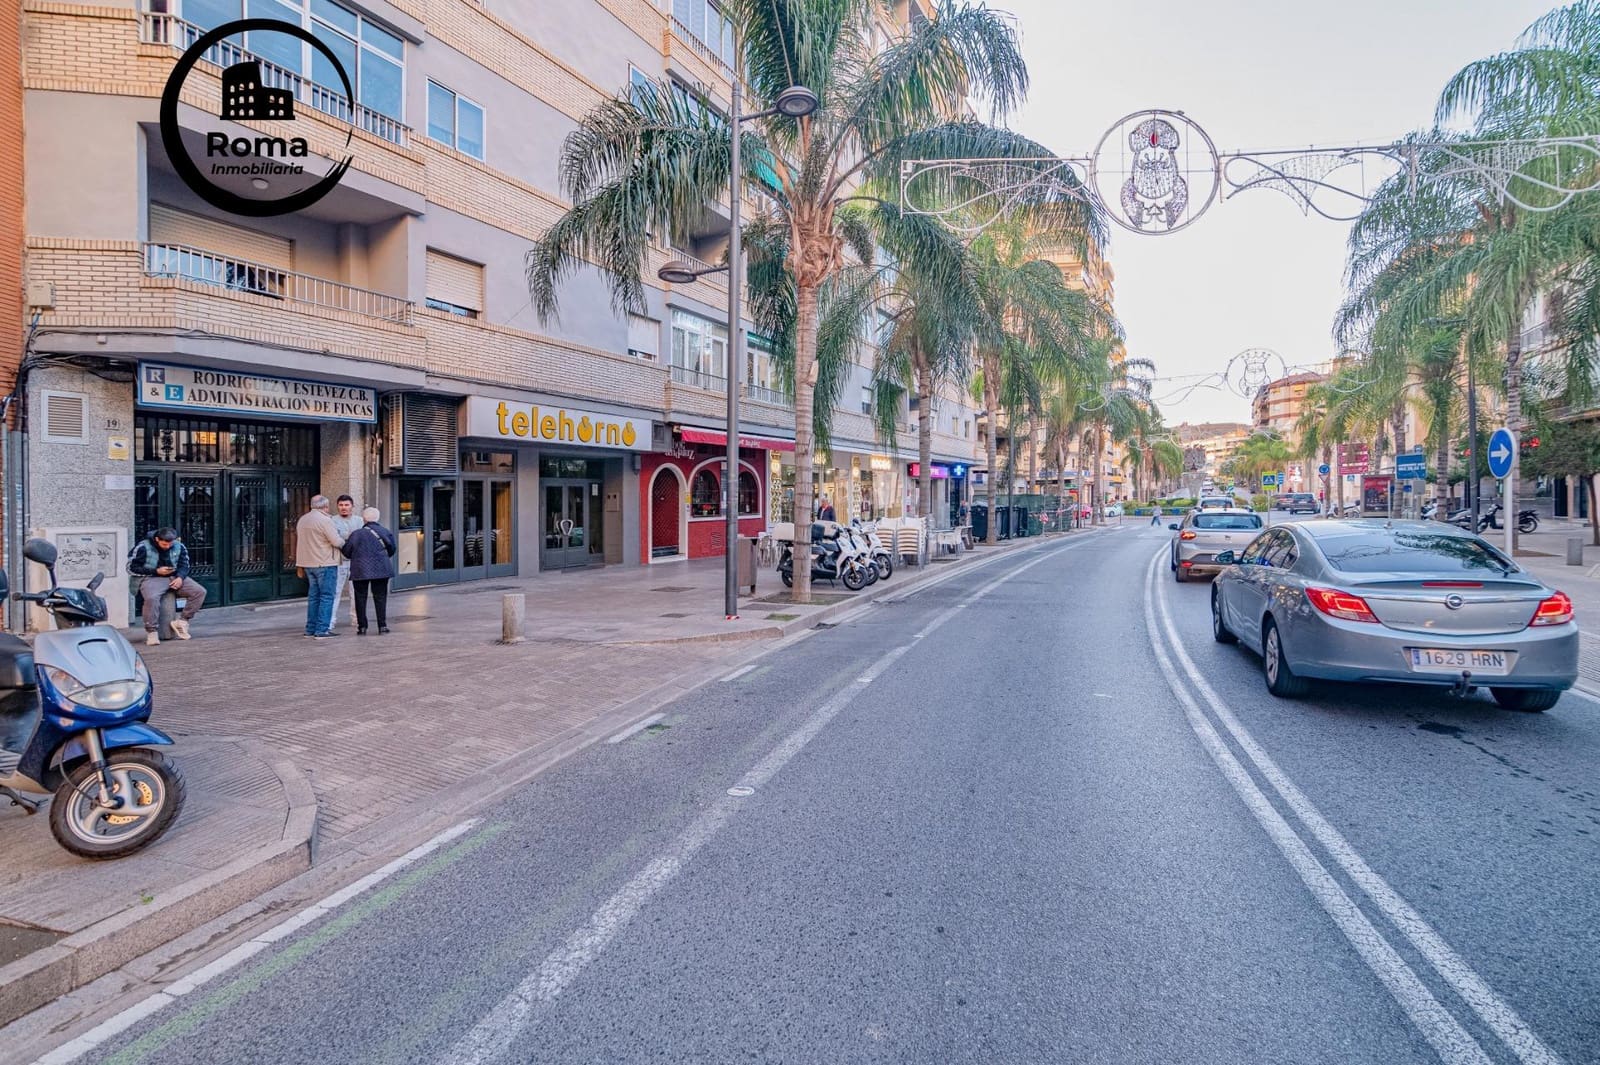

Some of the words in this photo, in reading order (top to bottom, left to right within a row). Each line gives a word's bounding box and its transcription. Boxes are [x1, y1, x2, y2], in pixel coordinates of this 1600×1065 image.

[150, 368, 162, 382] R
[150, 387, 160, 397] &
[169, 386, 180, 399] E
[193, 370, 280, 393] RODRIGUEZ
[282, 380, 291, 394] Y
[293, 382, 347, 400] ESTEVEZ
[348, 388, 369, 402] C.B.
[313, 400, 331, 414] DE
[333, 402, 373, 416] FINCAS
[106, 418, 118, 428] 19
[496, 401, 636, 447] telehorno
[1425, 651, 1466, 666] 1629
[1471, 653, 1503, 667] HRN
